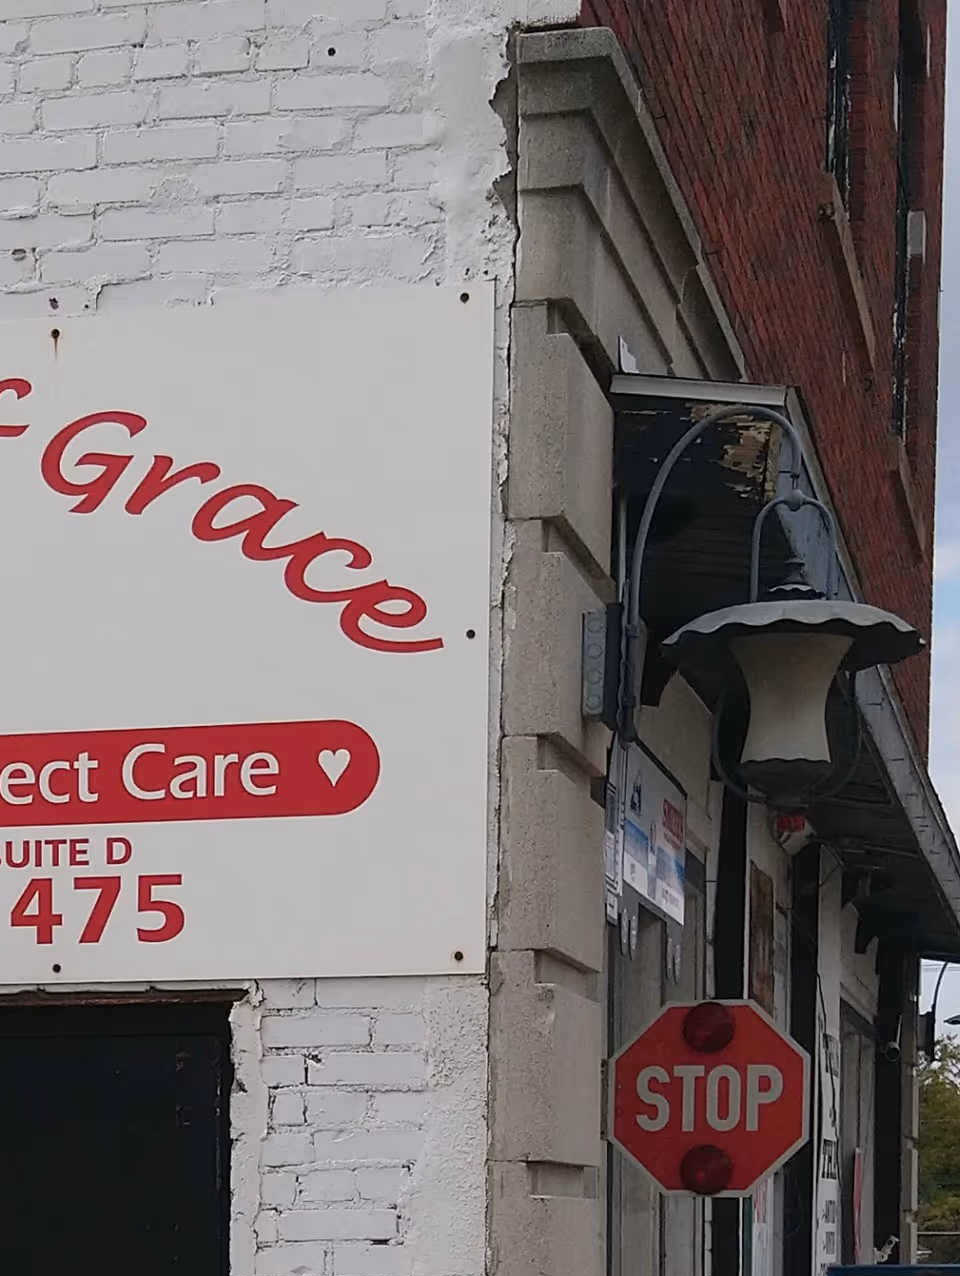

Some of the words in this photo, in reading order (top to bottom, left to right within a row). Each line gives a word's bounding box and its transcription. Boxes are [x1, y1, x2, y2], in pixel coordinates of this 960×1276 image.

[40, 410, 444, 654] Grace
[123, 744, 278, 799] Care
[106, 837, 132, 865] D
[637, 1065, 783, 1131] STOP
